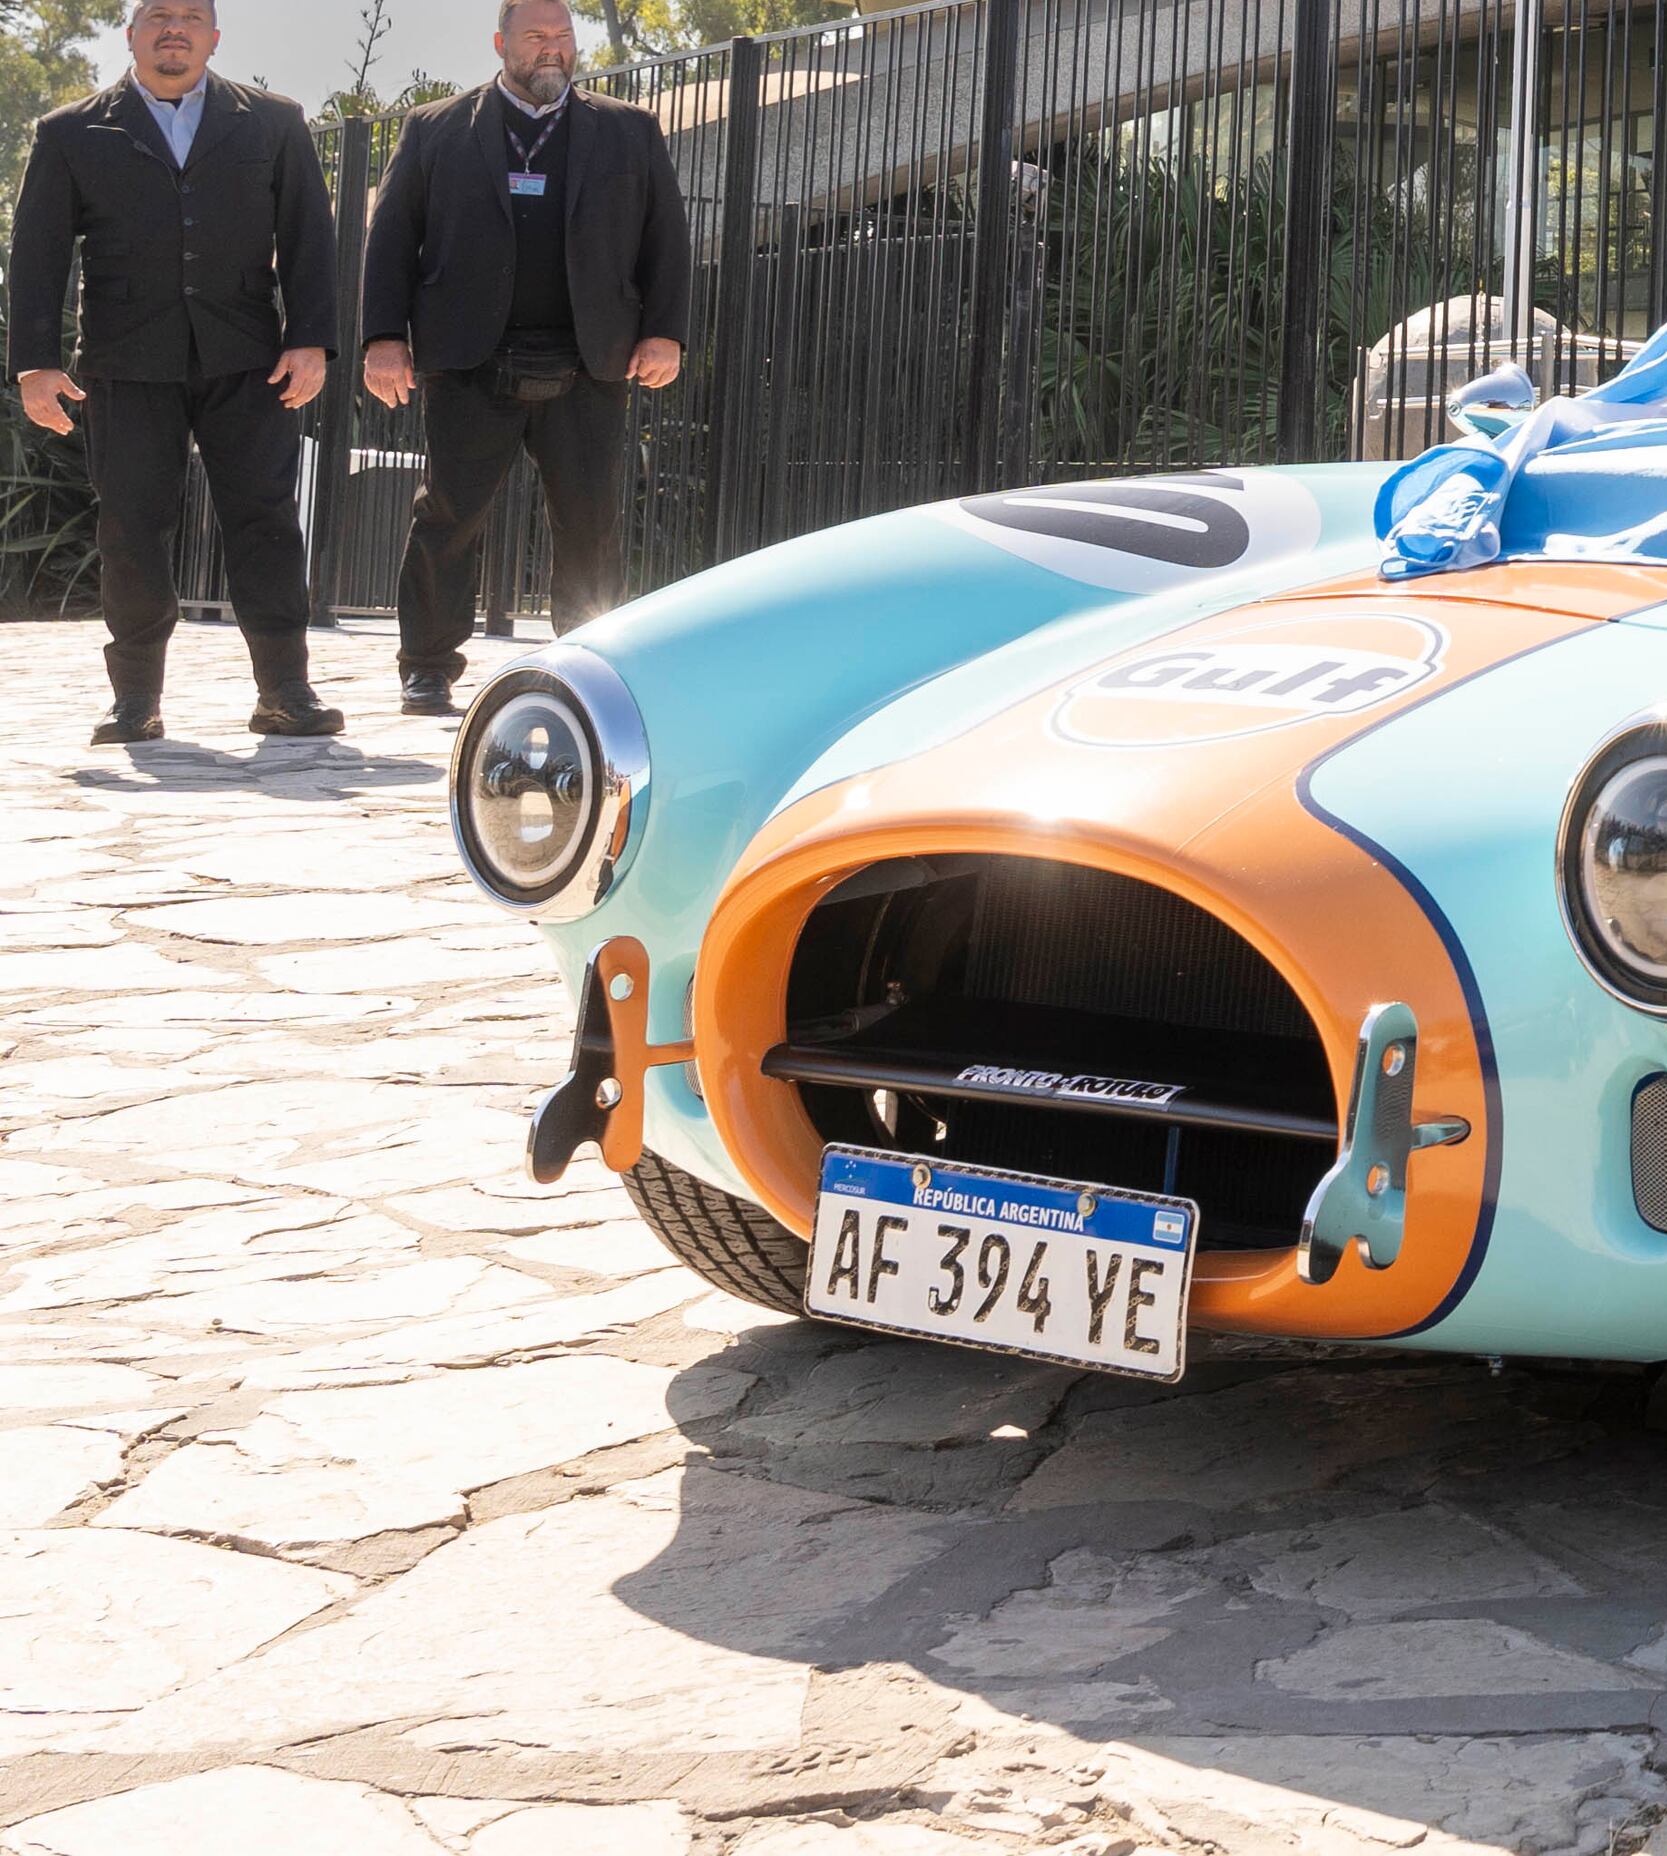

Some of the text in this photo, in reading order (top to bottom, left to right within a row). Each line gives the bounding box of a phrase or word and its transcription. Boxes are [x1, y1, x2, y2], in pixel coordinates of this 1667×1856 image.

[1098, 652, 1409, 704] Gulf
[912, 1186, 1085, 1232] REPÚBLICA ARGENTINA
[826, 1208, 1165, 1355] AF 394 YE
